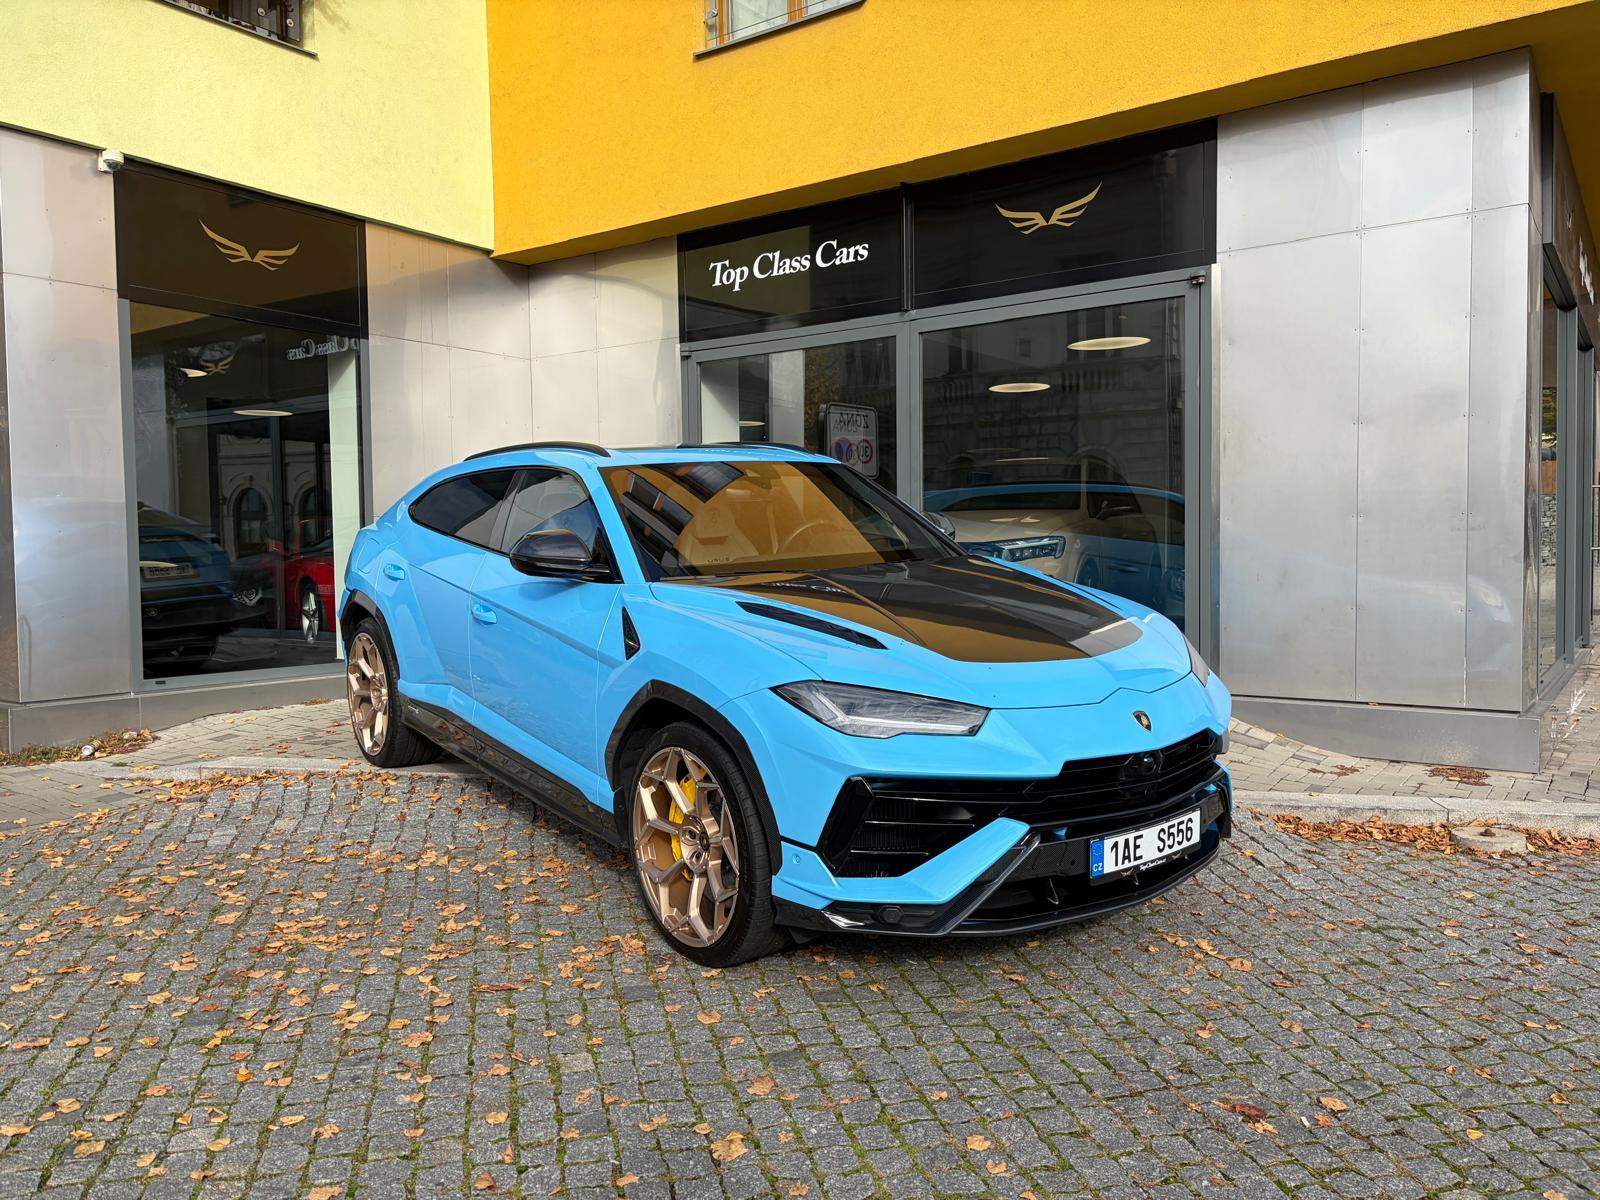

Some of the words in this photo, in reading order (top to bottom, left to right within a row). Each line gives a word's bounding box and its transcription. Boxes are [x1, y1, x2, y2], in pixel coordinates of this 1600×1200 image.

[708, 259, 749, 292] Top
[752, 250, 811, 279] Class
[815, 239, 869, 268] Cars
[1092, 862, 1103, 872] CZ
[1110, 834, 1144, 867] 1AE
[1157, 817, 1194, 853] S556
